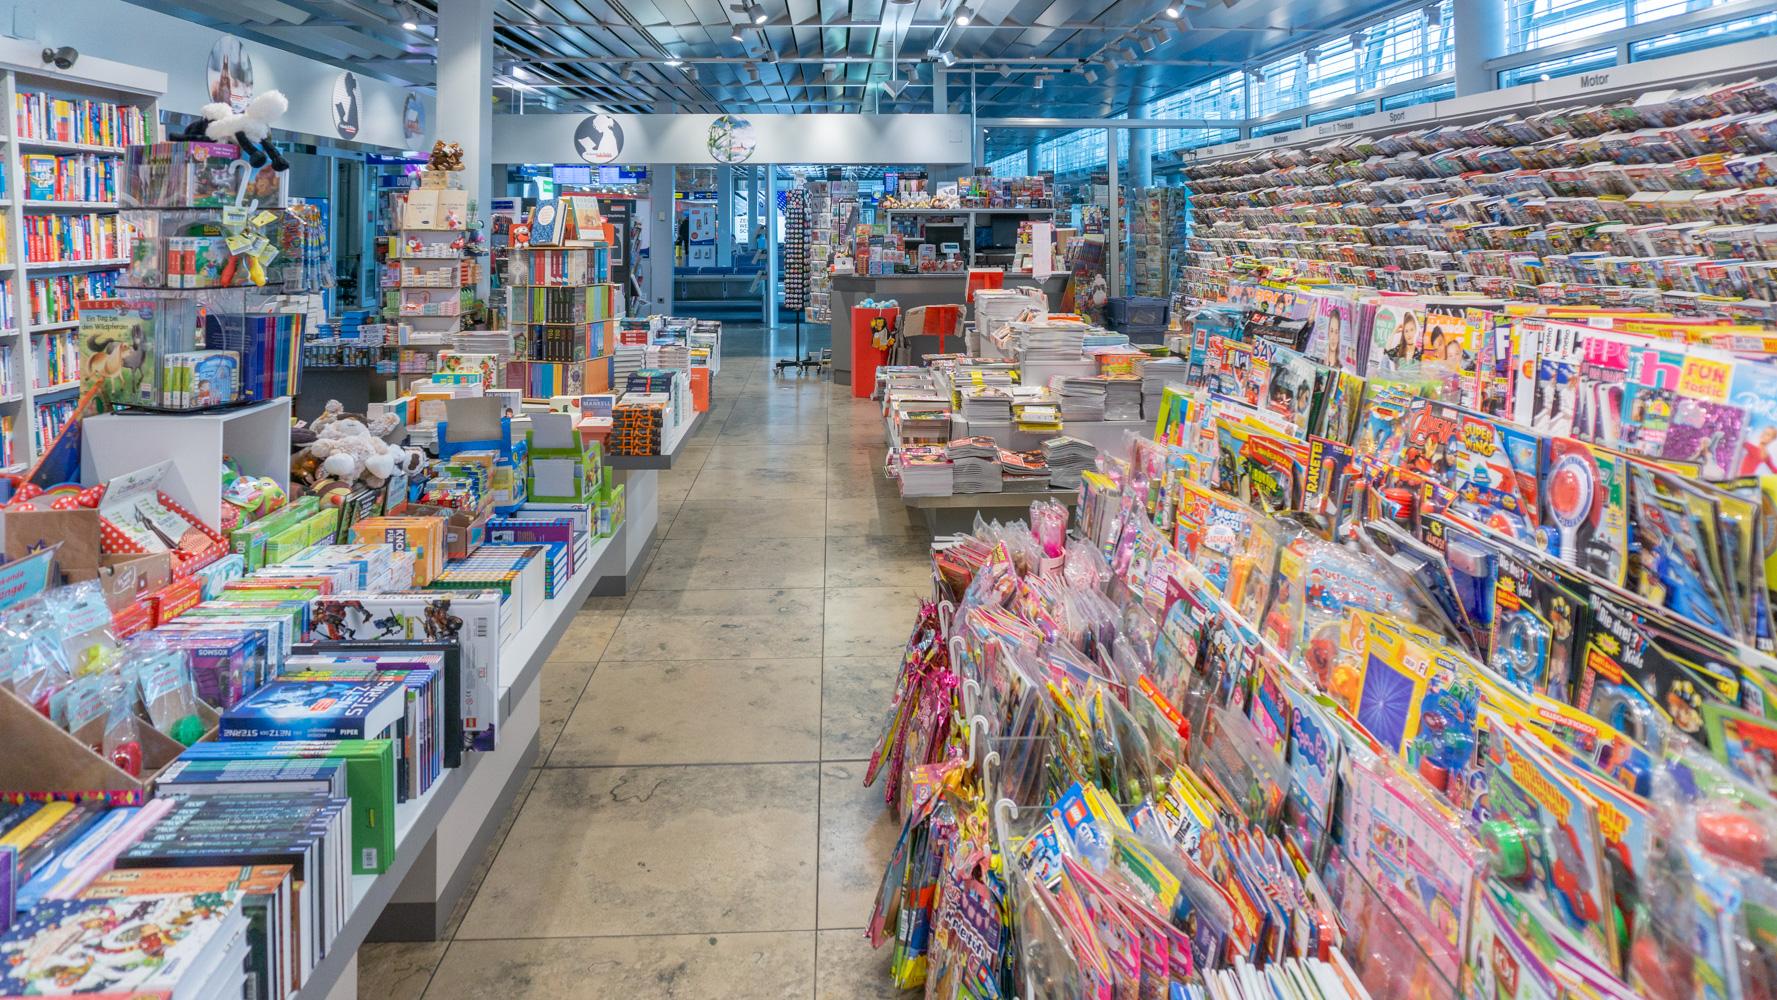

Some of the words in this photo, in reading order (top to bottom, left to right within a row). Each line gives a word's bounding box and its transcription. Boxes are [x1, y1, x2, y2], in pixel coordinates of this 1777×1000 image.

[1580, 73, 1609, 88] Motor
[1389, 111, 1406, 123] Sport
[1337, 122, 1354, 130] Trinken
[1273, 135, 1288, 143] Wohnen
[1463, 422, 1494, 444] SUPER
[1464, 436, 1497, 458] WINGS
[1305, 441, 1325, 494] RAKETE!
[394, 528, 405, 551] KNO
[1517, 582, 1532, 598] Kids
[1597, 606, 1613, 629] Die
[1611, 620, 1633, 643] drei
[198, 648, 228, 657] KOSMOS
[1621, 645, 1644, 669] Kids
[345, 678, 396, 717] STERNE
[223, 729, 259, 737] STERNE
[268, 729, 292, 737] NETZ
[339, 728, 359, 736] PIPER
